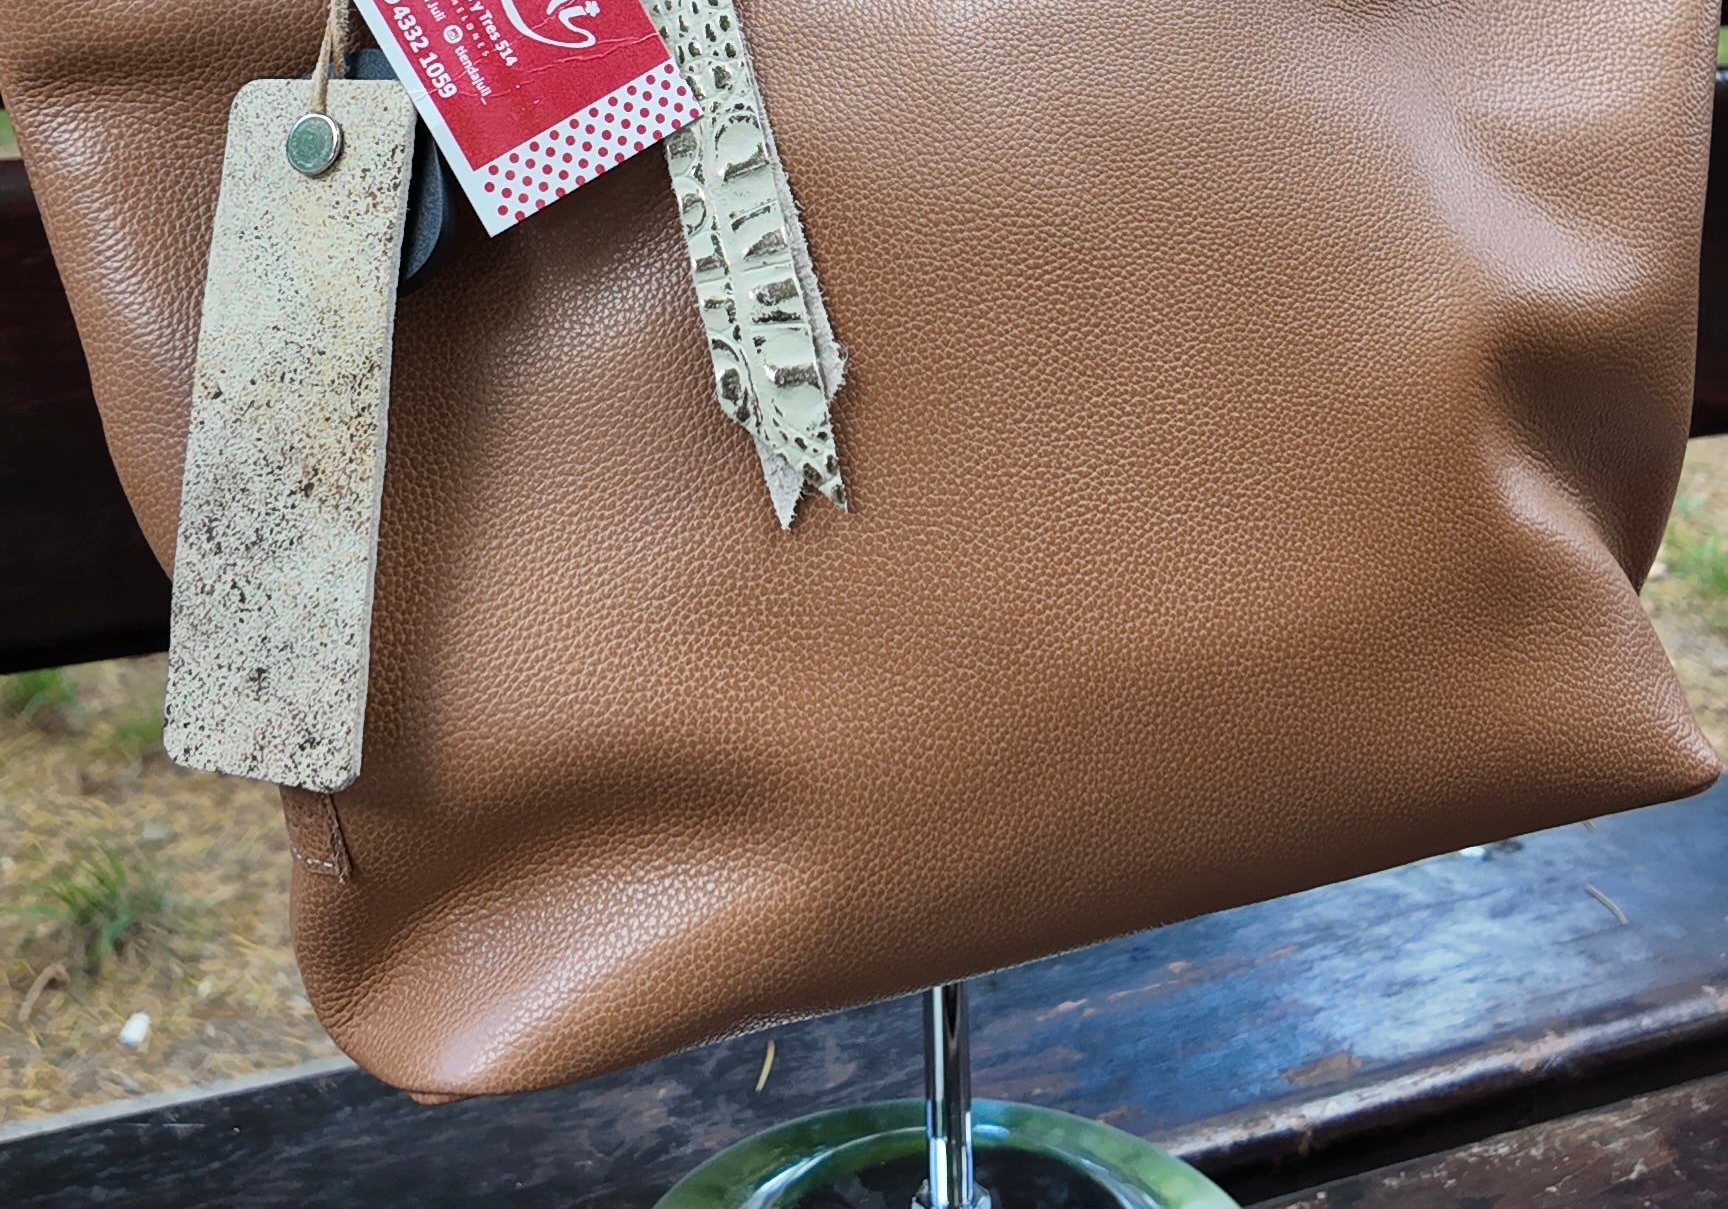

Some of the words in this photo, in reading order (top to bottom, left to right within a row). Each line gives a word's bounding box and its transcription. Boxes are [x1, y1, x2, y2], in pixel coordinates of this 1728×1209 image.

[427, 1, 447, 22] Juli
[469, 1, 484, 12] y
[479, 9, 500, 41] Tres
[495, 40, 519, 67] 514
[393, 6, 430, 53] 4332
[418, 52, 458, 99] 1059
